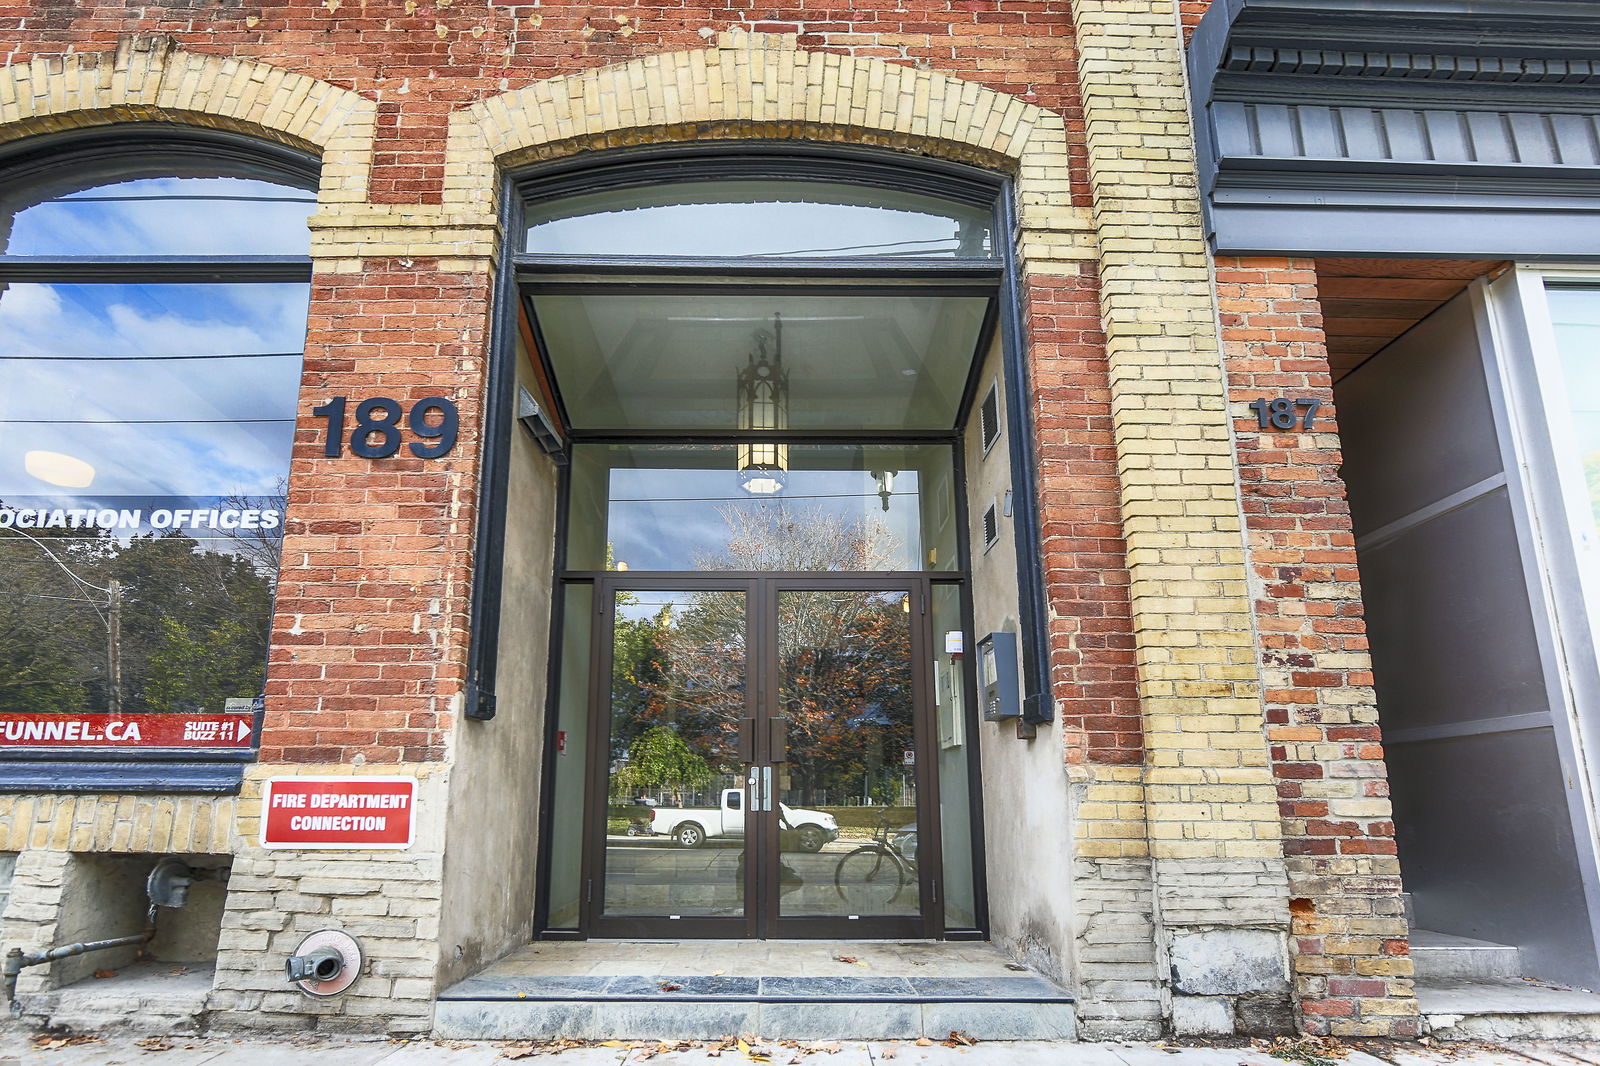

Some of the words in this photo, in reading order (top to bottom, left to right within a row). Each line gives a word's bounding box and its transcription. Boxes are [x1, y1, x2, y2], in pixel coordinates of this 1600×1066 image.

[1249, 397, 1321, 430] 187
[313, 396, 460, 459] 189
[0, 509, 141, 528] OCIATION
[150, 509, 280, 529] OFFICES
[184, 721, 220, 731] SUITE
[221, 721, 234, 731] #1
[183, 731, 216, 740] BUZZ
[220, 731, 233, 740] 11
[272, 794, 306, 808] FIRE
[310, 794, 409, 809] DEPARTMENT
[290, 815, 386, 831] CONNECTION
